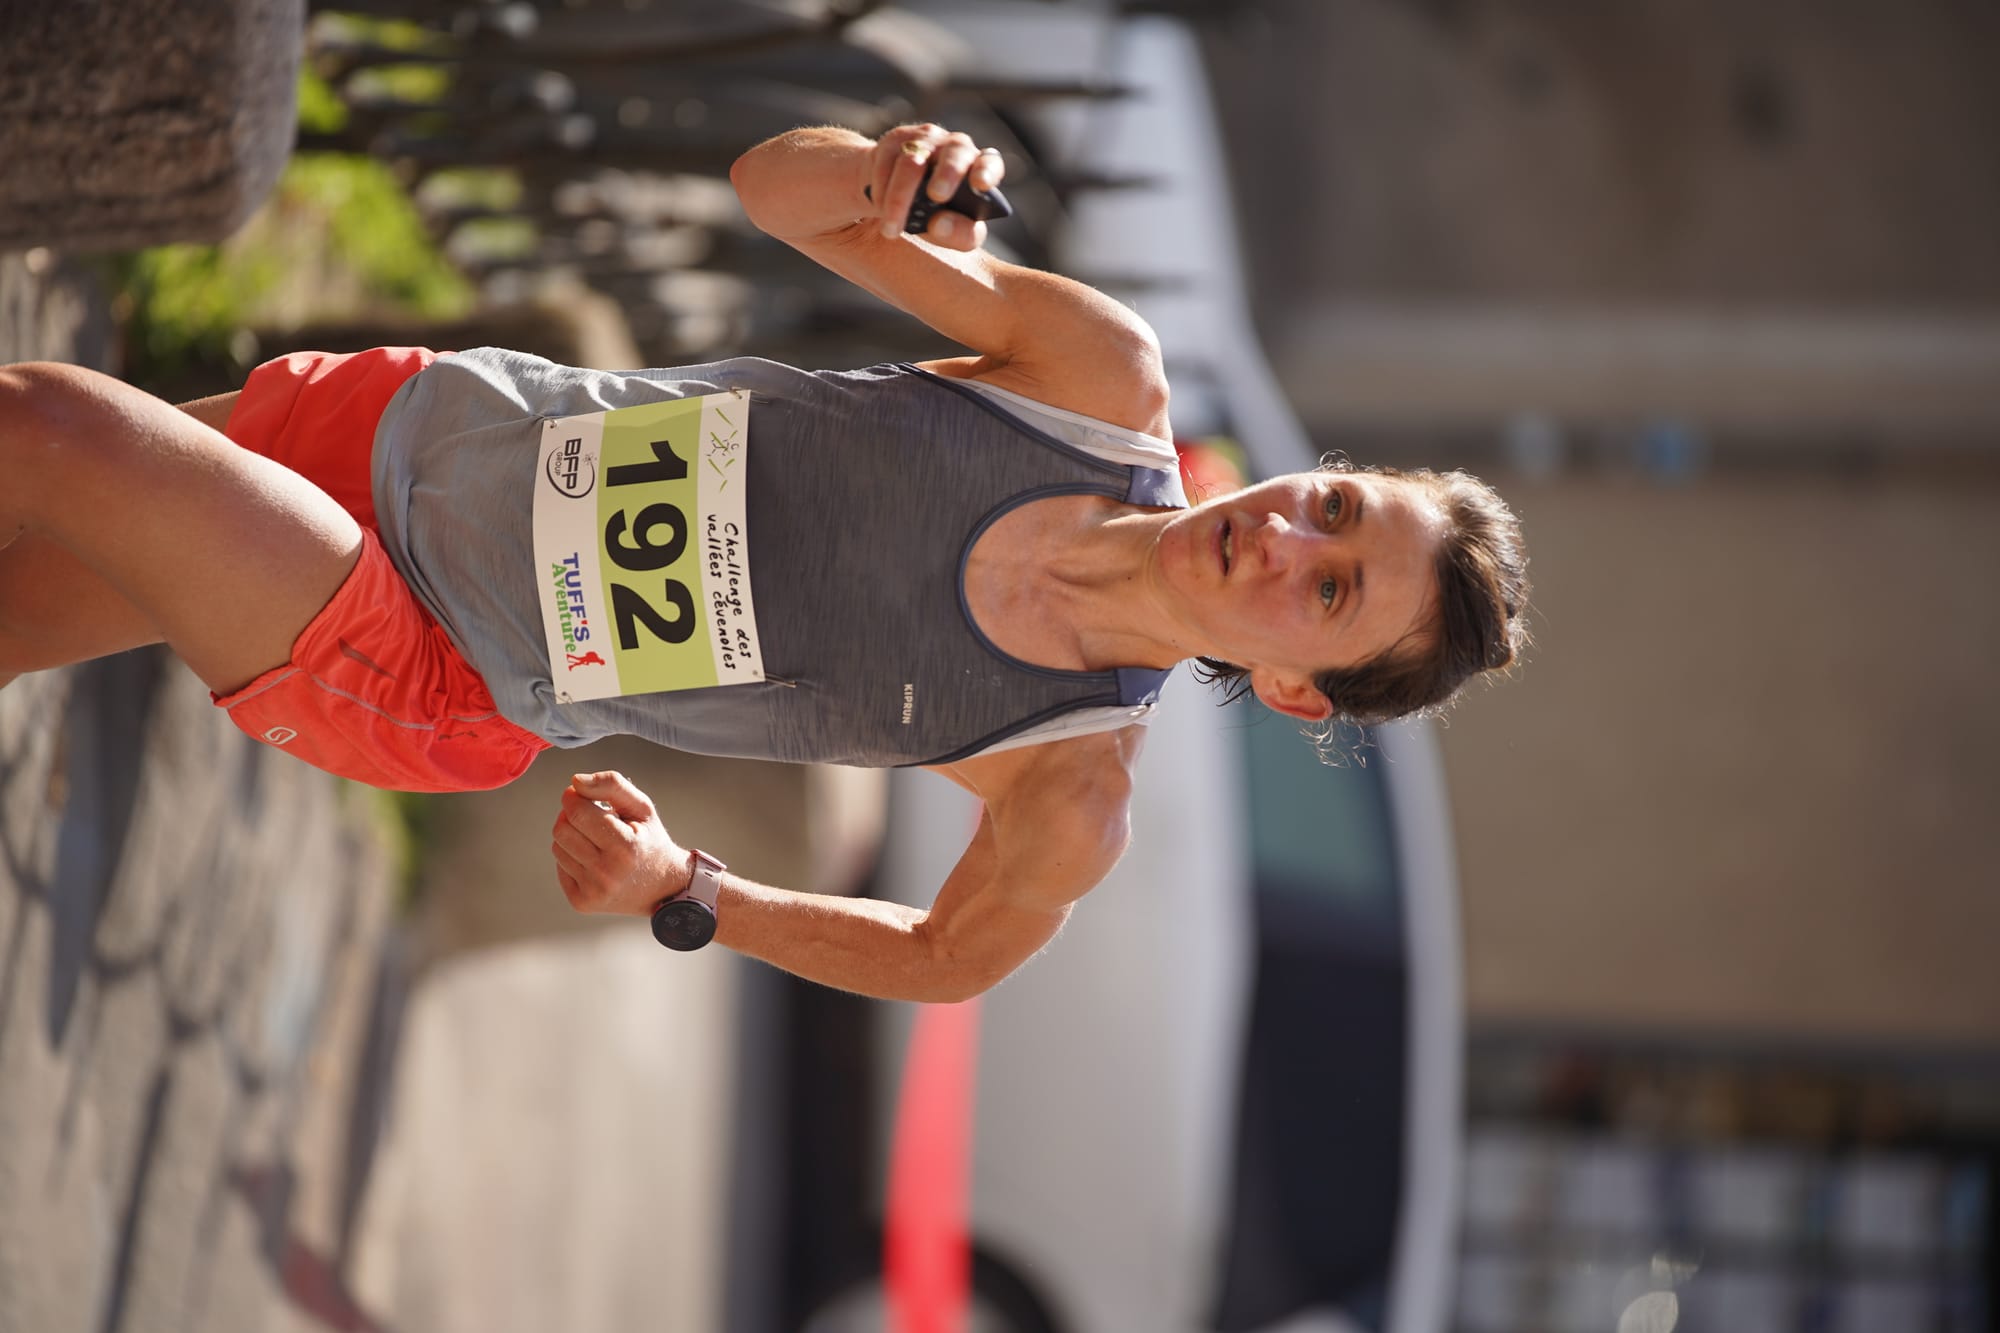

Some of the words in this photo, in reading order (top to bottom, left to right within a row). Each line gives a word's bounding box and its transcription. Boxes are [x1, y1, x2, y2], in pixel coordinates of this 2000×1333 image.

[555, 451, 563, 477] GROUP
[562, 438, 582, 490] BFP
[605, 440, 696, 650] 192
[707, 514, 722, 579] vallées
[551, 562, 577, 653] Aventure
[563, 552, 590, 642] TUFF'S
[724, 522, 742, 617] Challenge
[737, 628, 751, 659] des
[713, 591, 736, 670] cévenoles
[902, 683, 913, 724] KIPRUN
